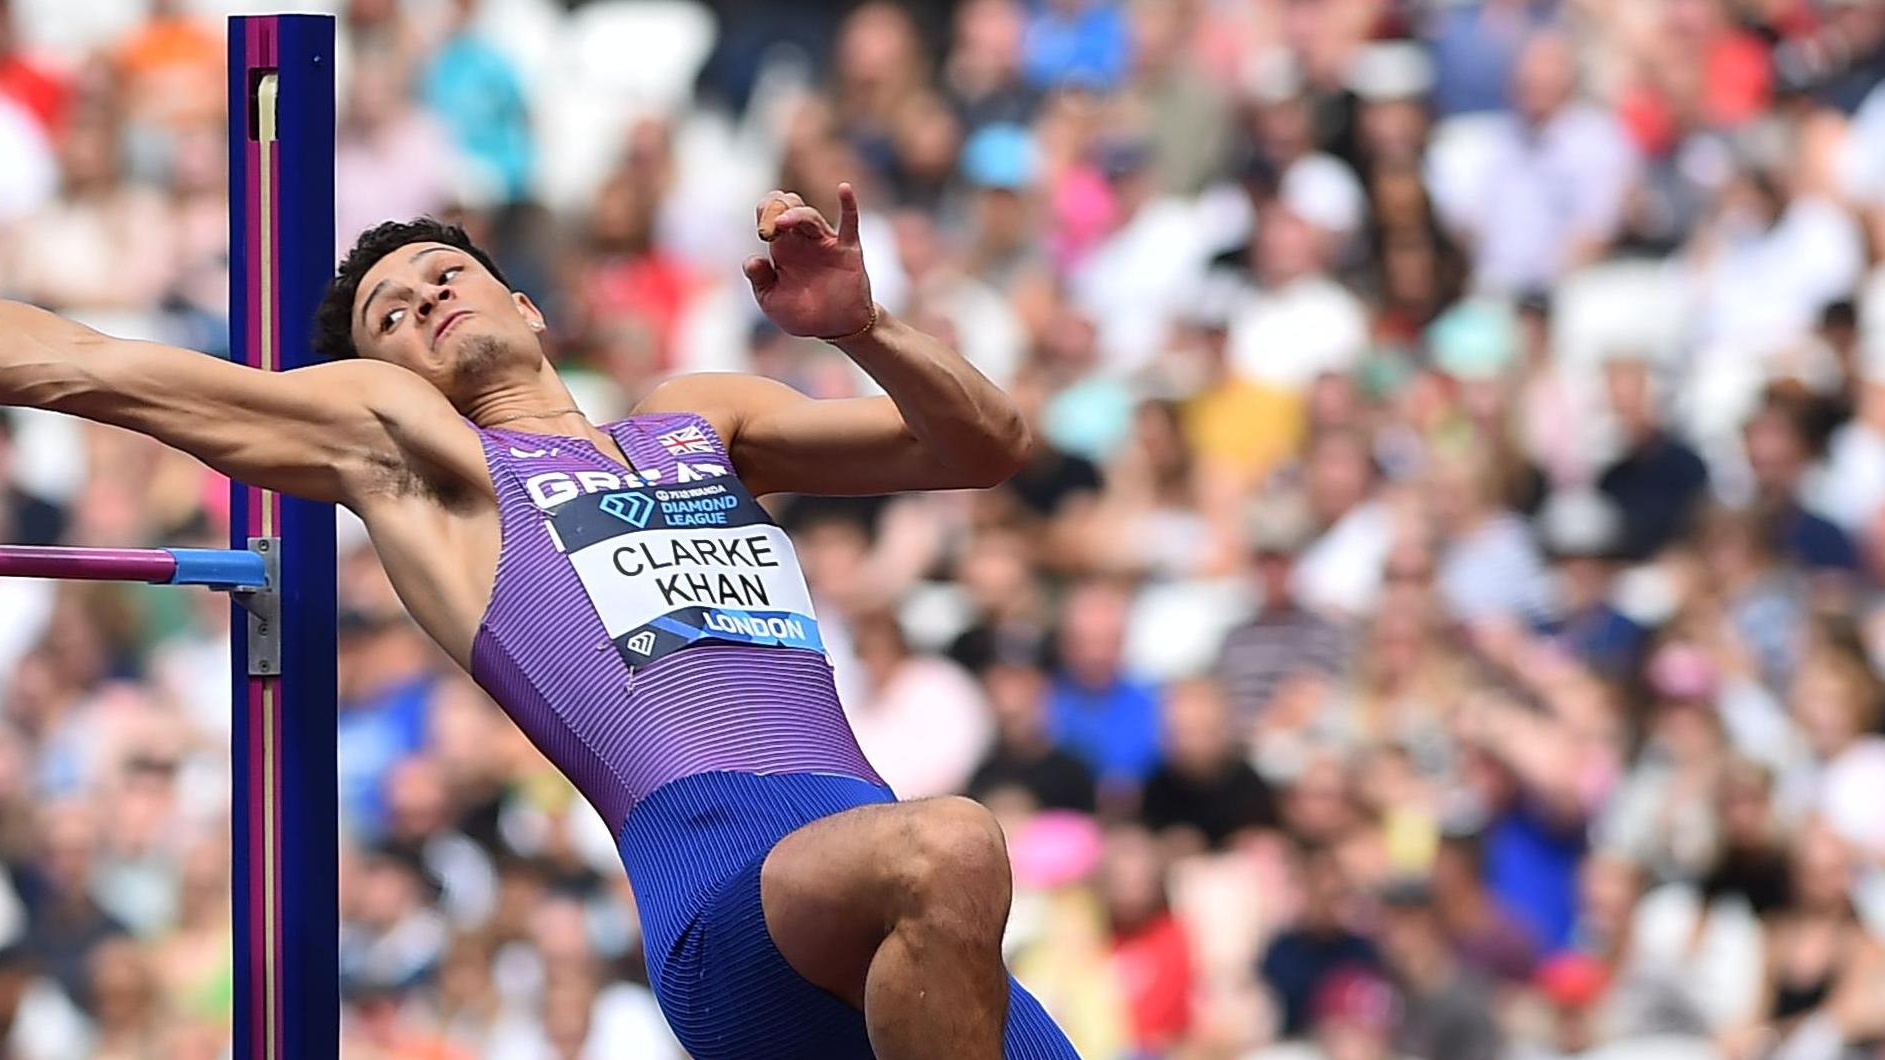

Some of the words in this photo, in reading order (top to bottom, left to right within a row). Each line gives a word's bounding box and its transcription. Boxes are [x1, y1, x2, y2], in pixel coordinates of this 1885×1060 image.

[660, 495, 738, 514] DIAMOND
[665, 512, 728, 526] LEAGUE
[612, 535, 779, 577] CLARKE
[655, 573, 771, 606] KHAN
[702, 611, 806, 641] LONDON
